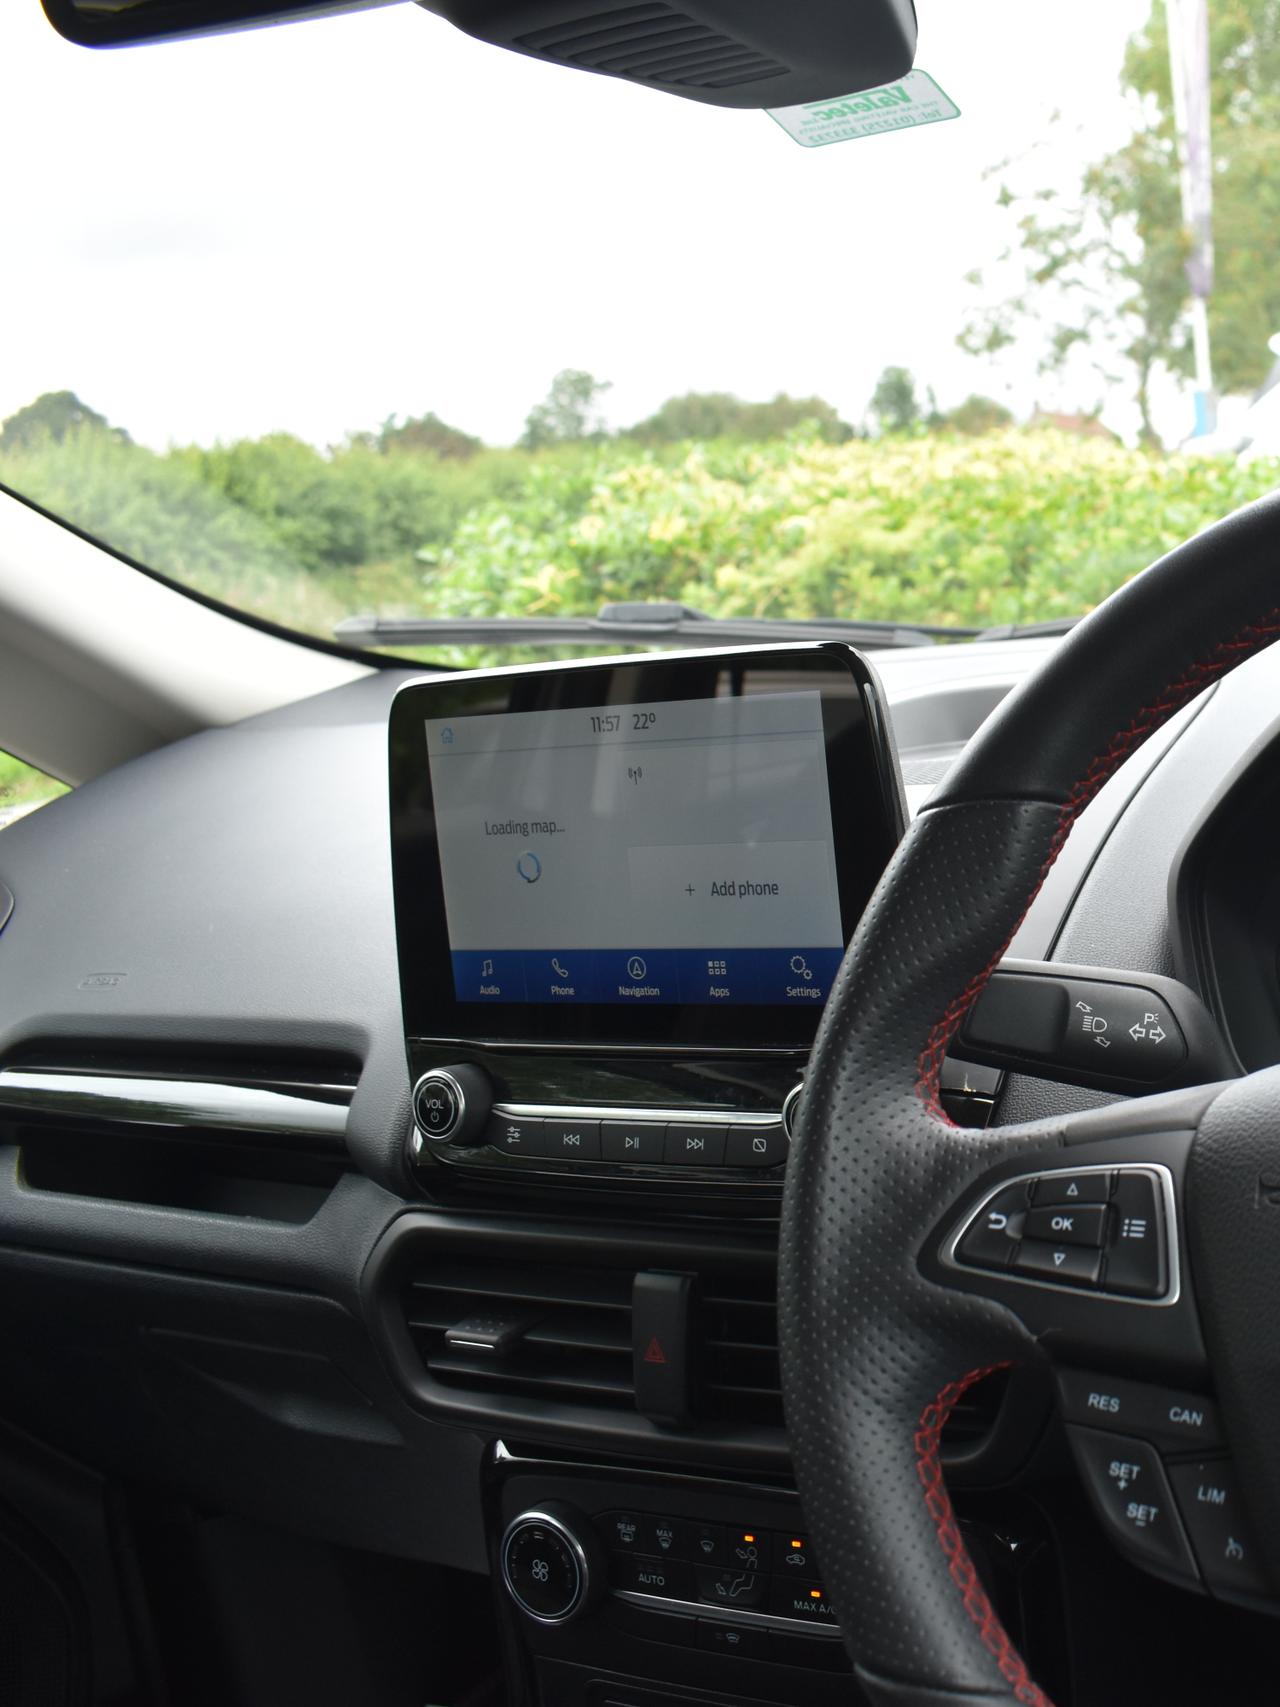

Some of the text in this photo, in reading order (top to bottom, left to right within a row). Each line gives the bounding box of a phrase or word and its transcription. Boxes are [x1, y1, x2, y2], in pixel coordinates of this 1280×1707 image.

[590, 715, 620, 733] 11:57
[484, 820, 566, 837] Loading map...
[711, 881, 779, 898] Add phone
[479, 985, 500, 995] Audio
[551, 985, 575, 995] Phone
[619, 985, 660, 996] Navigation
[709, 986, 730, 999] Apps
[786, 985, 821, 999] Settings
[425, 1099, 444, 1110] VOL
[1051, 1216, 1074, 1231] OK
[1088, 1393, 1120, 1412] RES
[1169, 1407, 1203, 1426] CAN
[1109, 1461, 1141, 1480] SET
[1197, 1485, 1226, 1504] LIM
[1127, 1502, 1159, 1522] SET
[617, 1522, 636, 1532] REAR
[656, 1529, 673, 1538] MAX
[638, 1573, 665, 1586] AUTO
[793, 1600, 817, 1612] MAX
